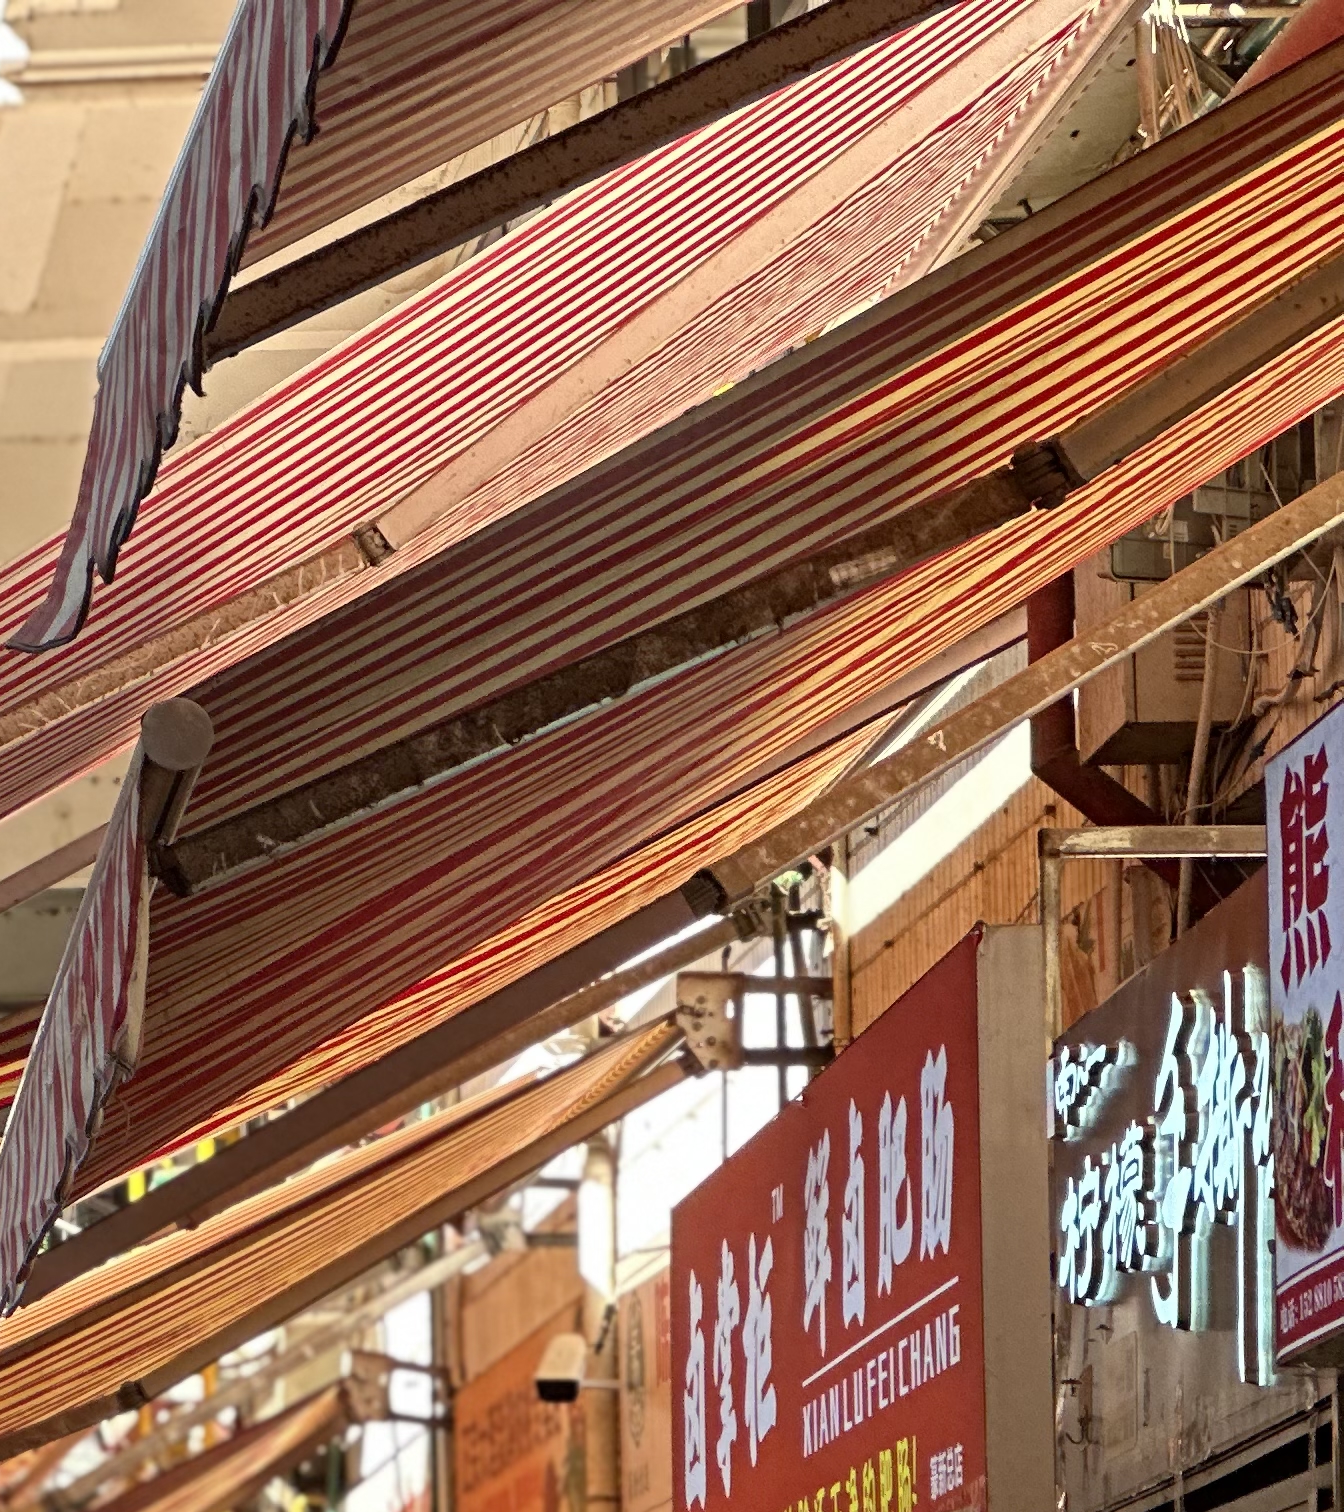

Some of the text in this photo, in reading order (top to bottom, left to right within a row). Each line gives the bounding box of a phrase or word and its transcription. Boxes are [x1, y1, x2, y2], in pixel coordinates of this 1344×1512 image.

[803, 1043, 955, 1359] 鲜卤肥肠
[1058, 1118, 1146, 1305] 柠檬
[684, 1231, 778, 1512] 卤掌柜
